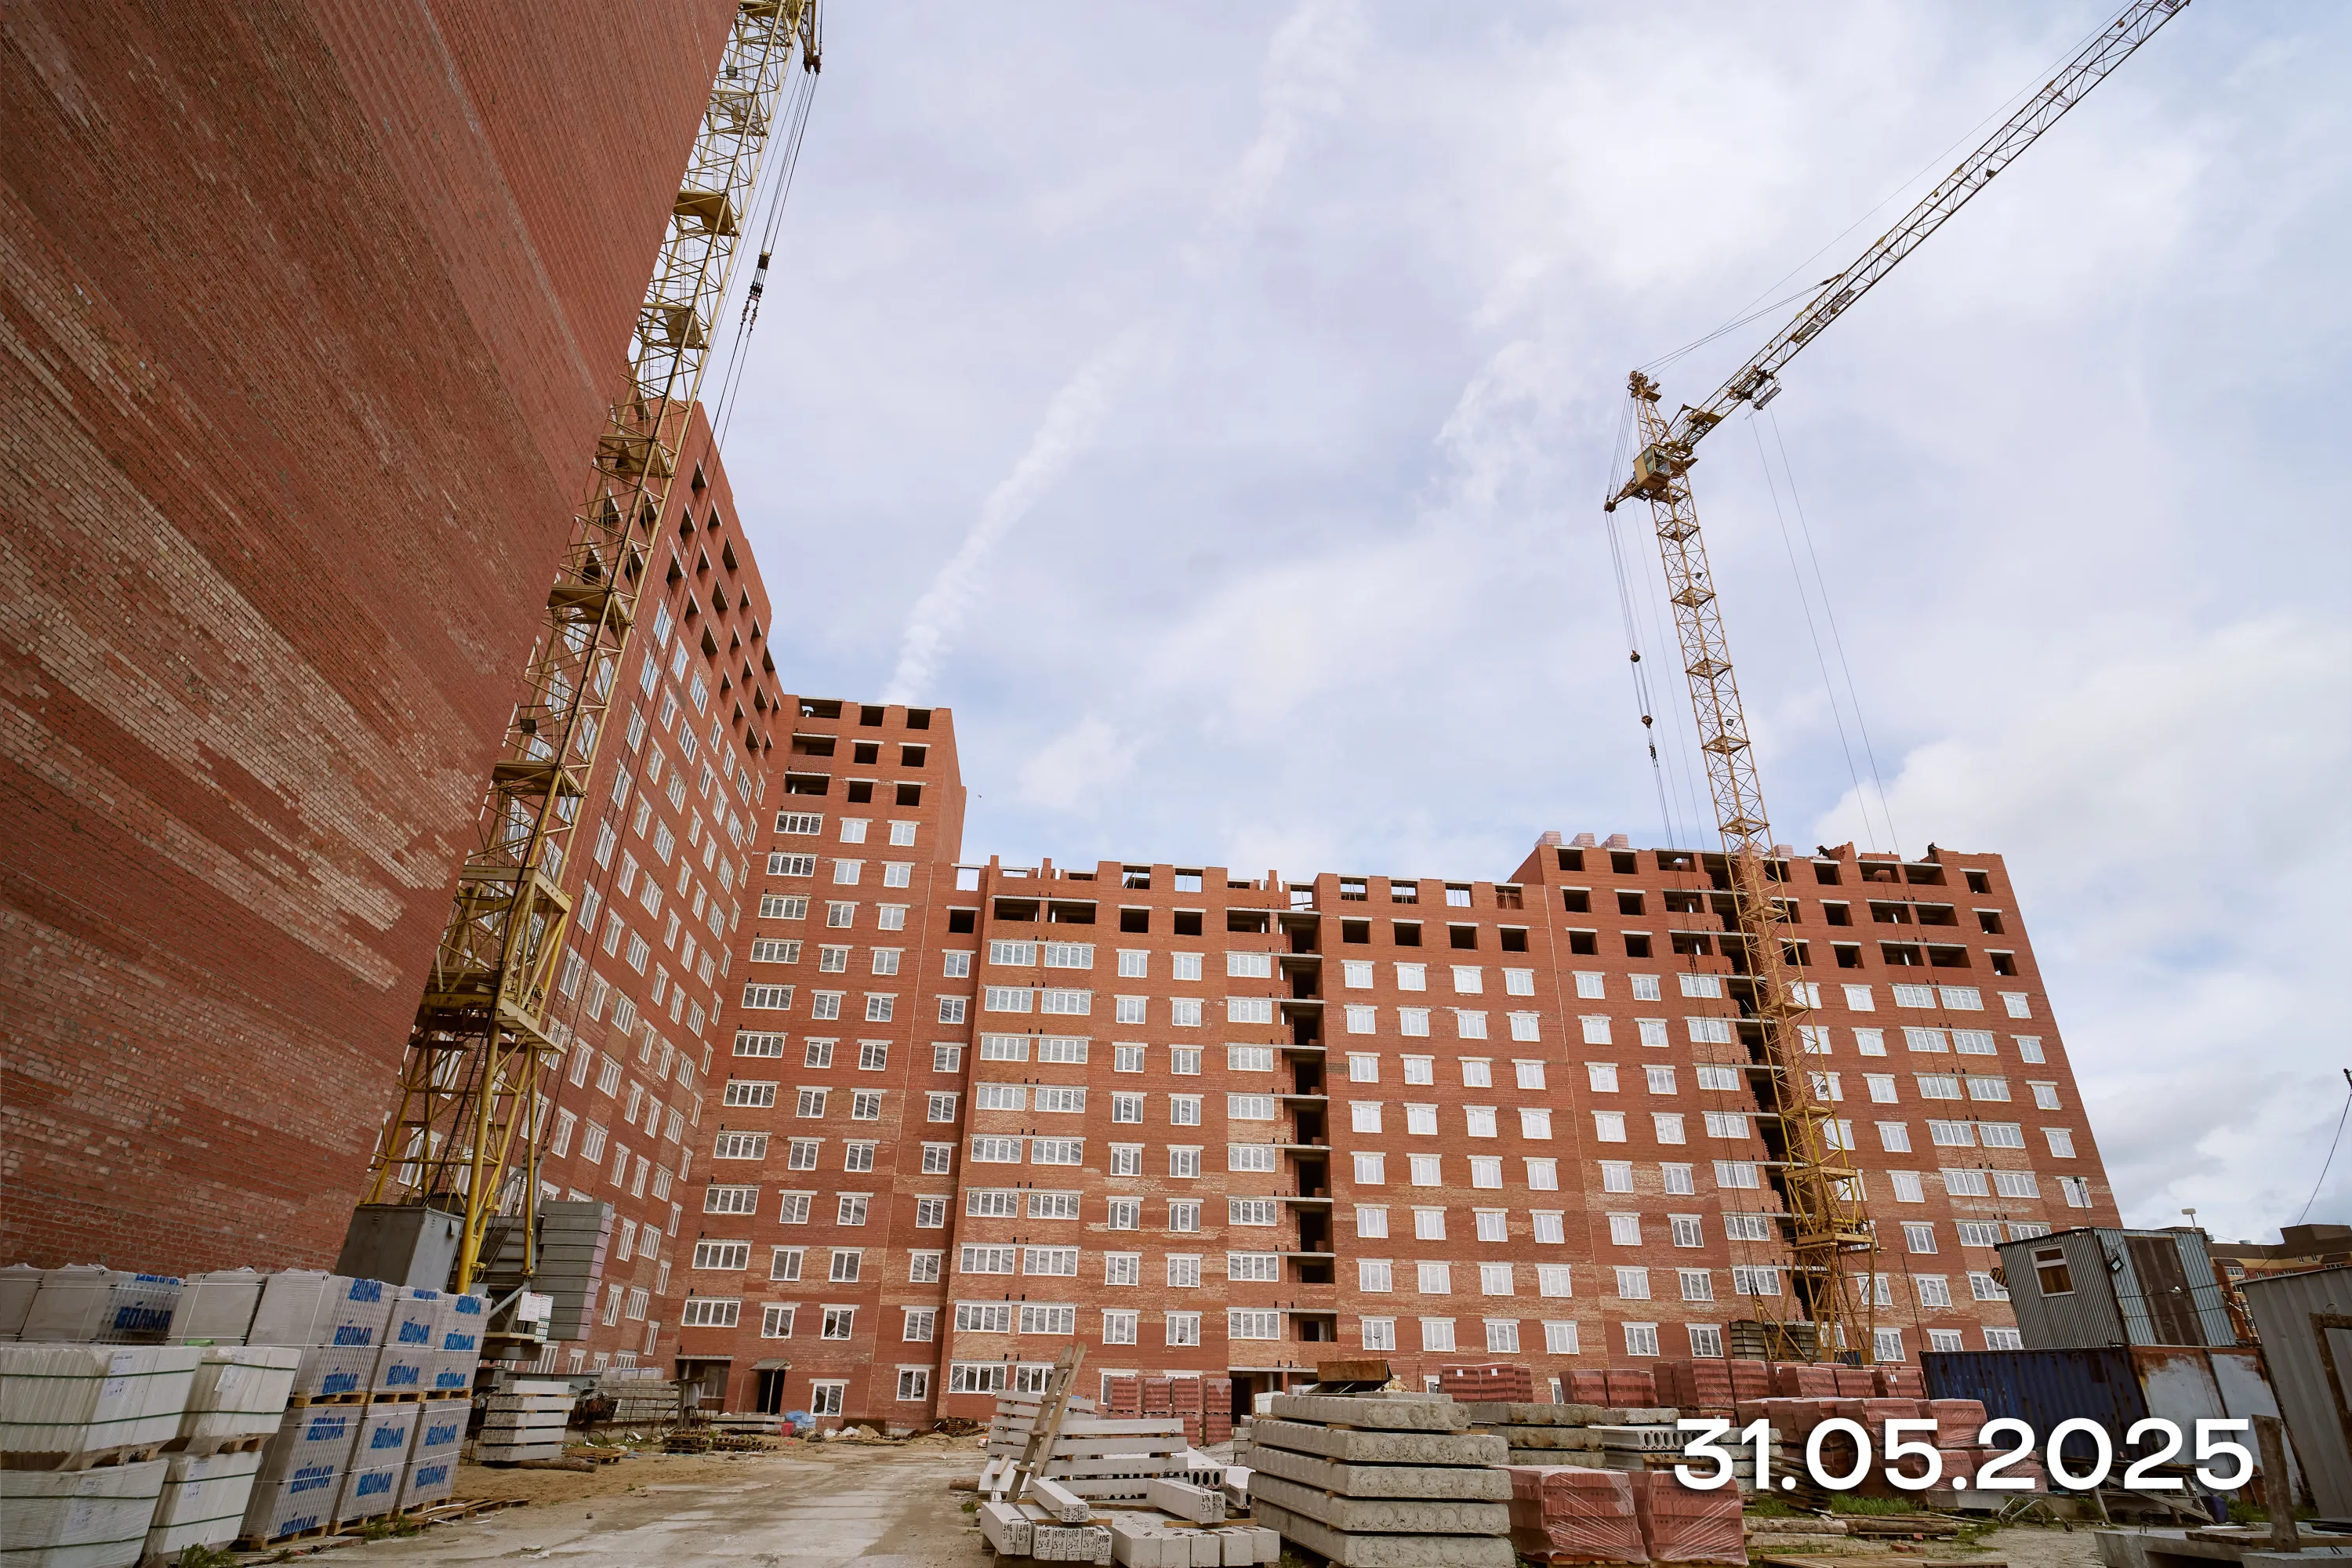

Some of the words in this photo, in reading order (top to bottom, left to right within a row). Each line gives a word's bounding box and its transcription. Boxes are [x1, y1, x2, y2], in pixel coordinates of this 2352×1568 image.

[334, 1319, 372, 1345] ВОЛМА
[398, 1316, 430, 1344] ВОЛМА
[444, 1328, 475, 1350] ВОЛМА
[386, 1359, 419, 1386] ВОЛМА
[436, 1367, 466, 1388] ВОЛМА
[307, 1410, 346, 1440] ВОЛМА
[371, 1421, 405, 1449] ВОЛМА
[425, 1421, 457, 1446] ВОЛМА
[290, 1461, 334, 1494] ВОЛМА
[356, 1468, 394, 1498] ВОЛМА
[416, 1461, 448, 1489] ВОЛМА
